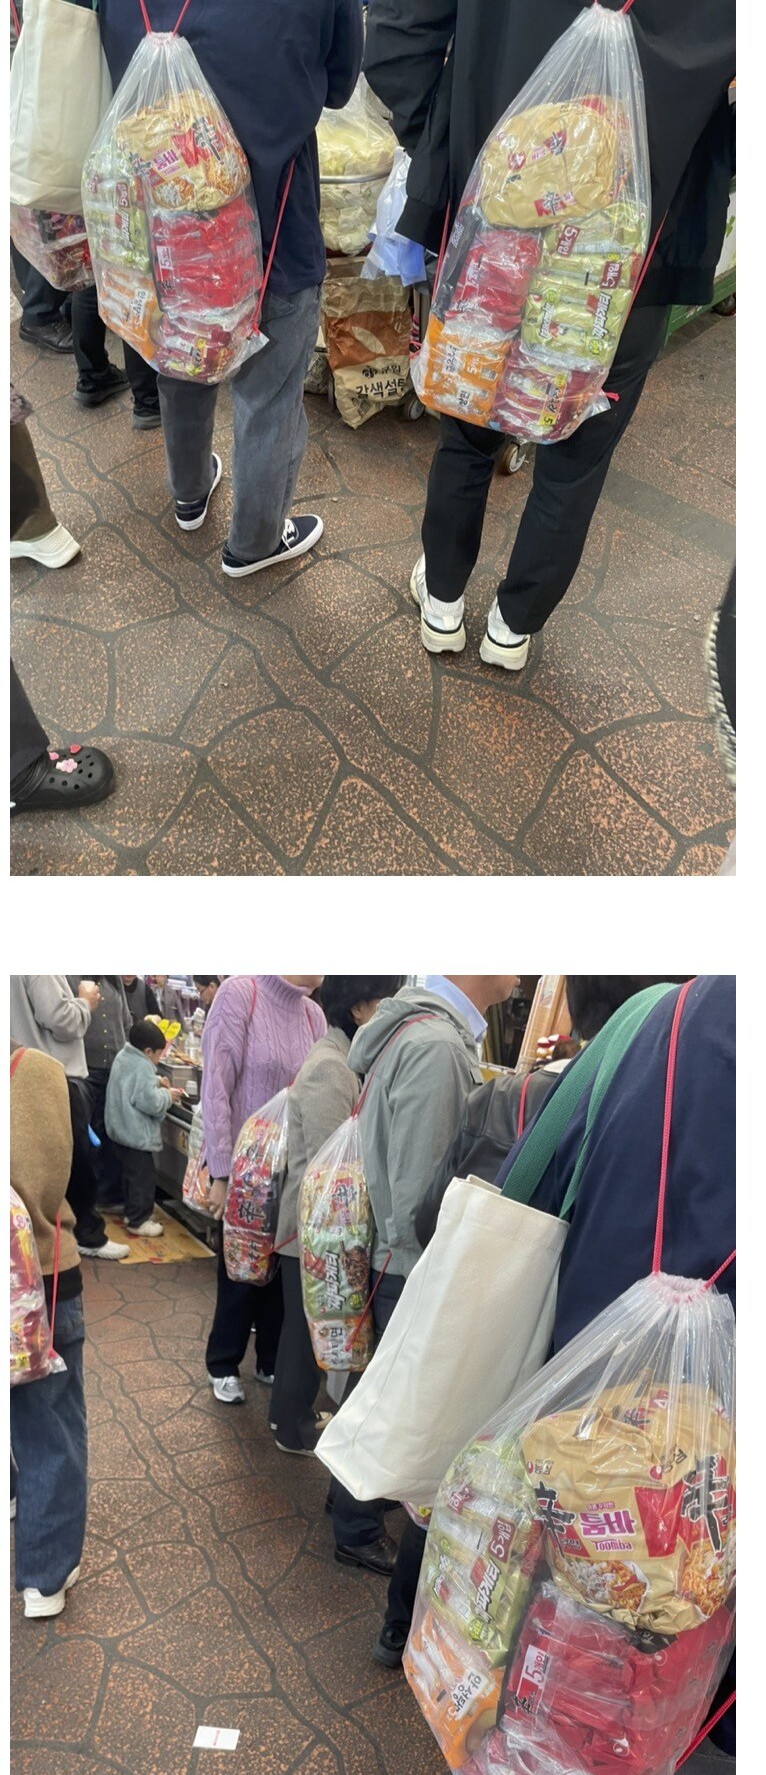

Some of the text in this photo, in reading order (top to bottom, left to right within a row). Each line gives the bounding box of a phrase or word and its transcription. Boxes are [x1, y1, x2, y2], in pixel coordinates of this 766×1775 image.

[592, 292, 612, 339] 짜파게티
[324, 1250, 346, 1310] 짜파게티
[579, 1511, 635, 1536] 툼바
[593, 1538, 633, 1551] Toomba
[475, 1559, 502, 1623] 짜파게티
